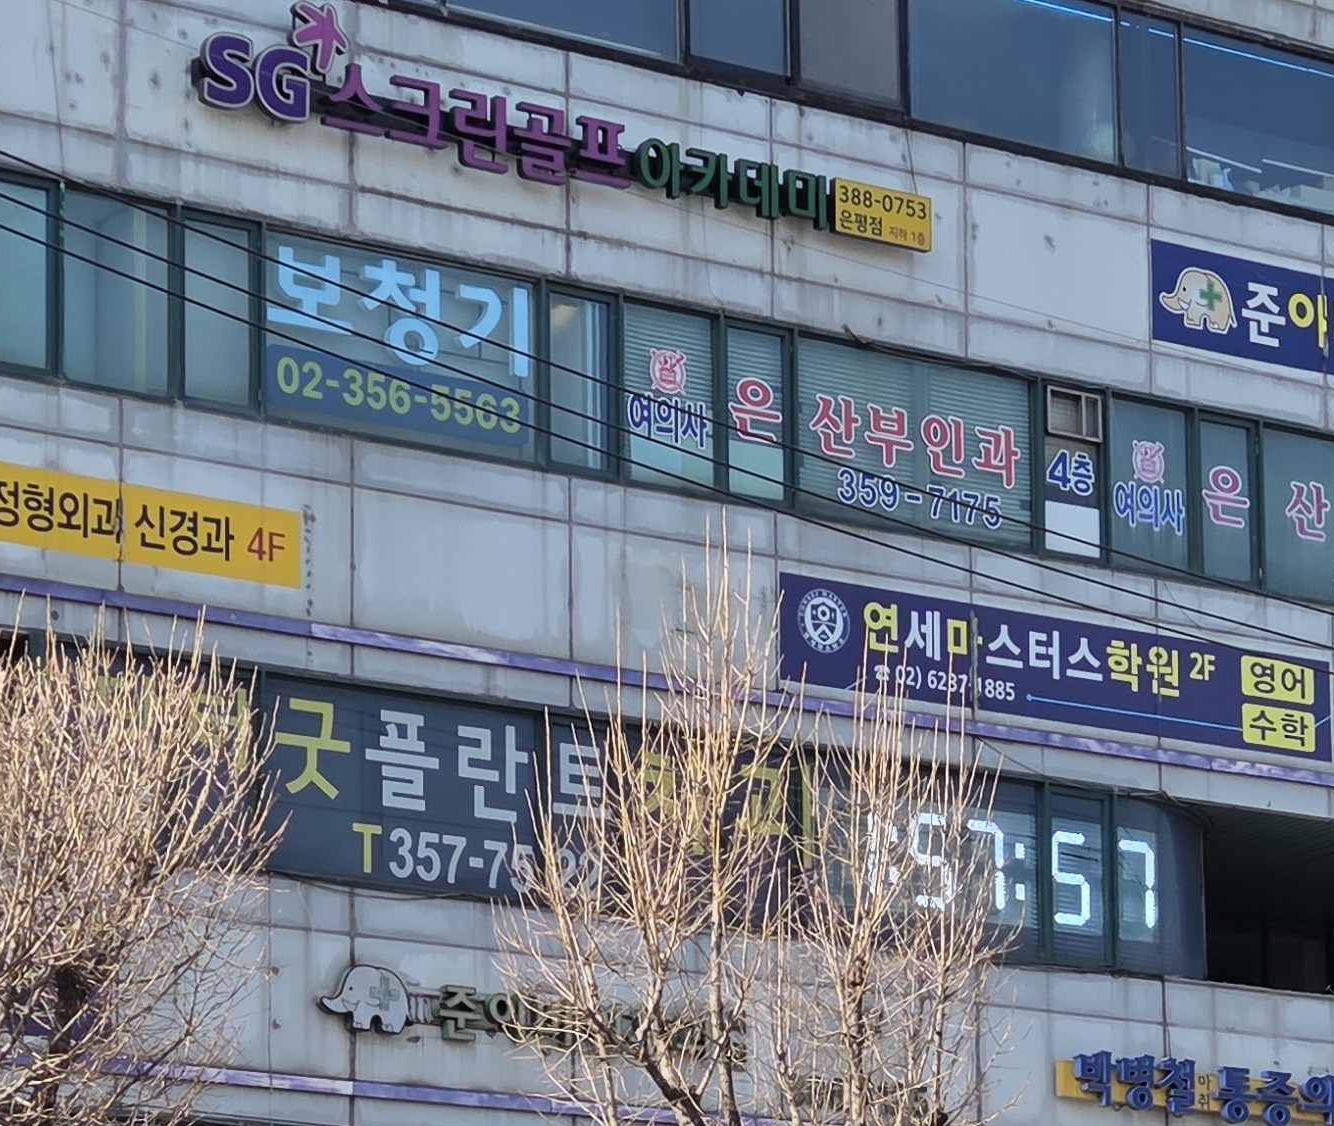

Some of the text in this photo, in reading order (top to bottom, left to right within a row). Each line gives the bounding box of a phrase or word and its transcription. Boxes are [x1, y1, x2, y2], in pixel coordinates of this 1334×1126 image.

[321, 62, 631, 190] 스크린골프
[838, 184, 928, 220] 388-0753
[838, 210, 884, 239] 은평점
[267, 245, 531, 380] 보청기
[276, 355, 522, 436] 02-356-5563
[627, 376, 1095, 497] 여의사 은 산부인과 4층
[1112, 480, 1186, 537] 여의사
[1202, 465, 1250, 529] 은
[134, 503, 235, 562] 신경과
[246, 526, 286, 562] 4F
[1189, 652, 1216, 680] 2F
[1249, 664, 1308, 700] 영어
[1248, 709, 1310, 751] 수학
[352, 822, 383, 874] T
